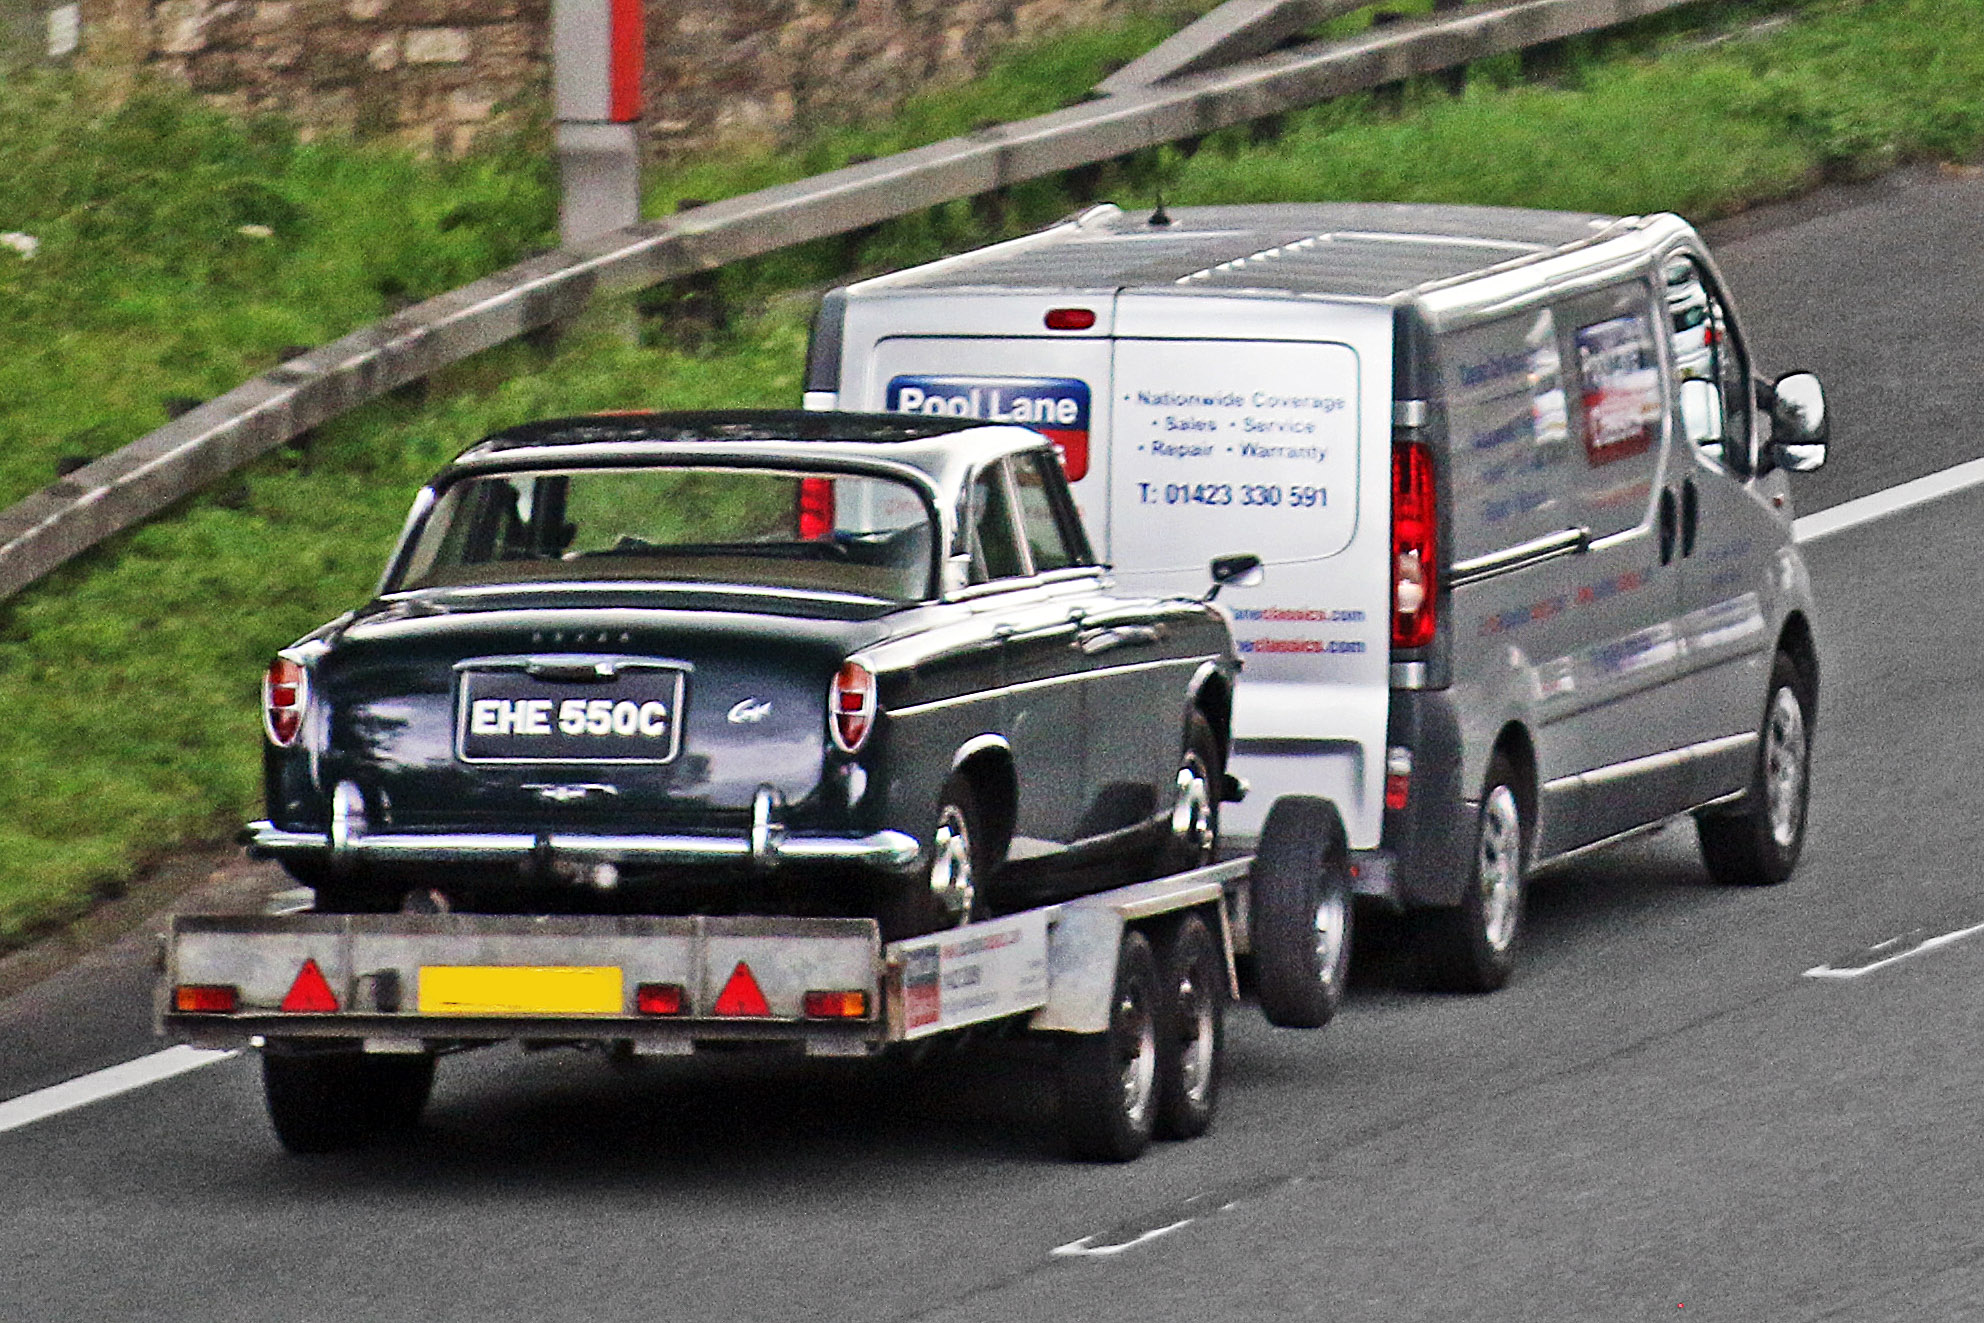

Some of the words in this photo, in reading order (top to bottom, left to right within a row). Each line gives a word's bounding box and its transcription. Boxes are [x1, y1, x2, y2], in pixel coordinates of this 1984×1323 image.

[900, 387, 980, 418] Pool
[990, 388, 1079, 425] Lane
[1137, 391, 1245, 407] Nationwide
[1252, 391, 1346, 412] Coverage
[1165, 415, 1217, 431] Sales
[1243, 417, 1316, 433] Service
[1151, 440, 1214, 458] Repair
[1240, 442, 1328, 463] Warranty
[1164, 484, 1233, 506] 01423
[1240, 484, 1283, 507] 330
[1289, 485, 1328, 508] 591
[470, 699, 553, 736] EHE
[557, 699, 668, 737] 550C
